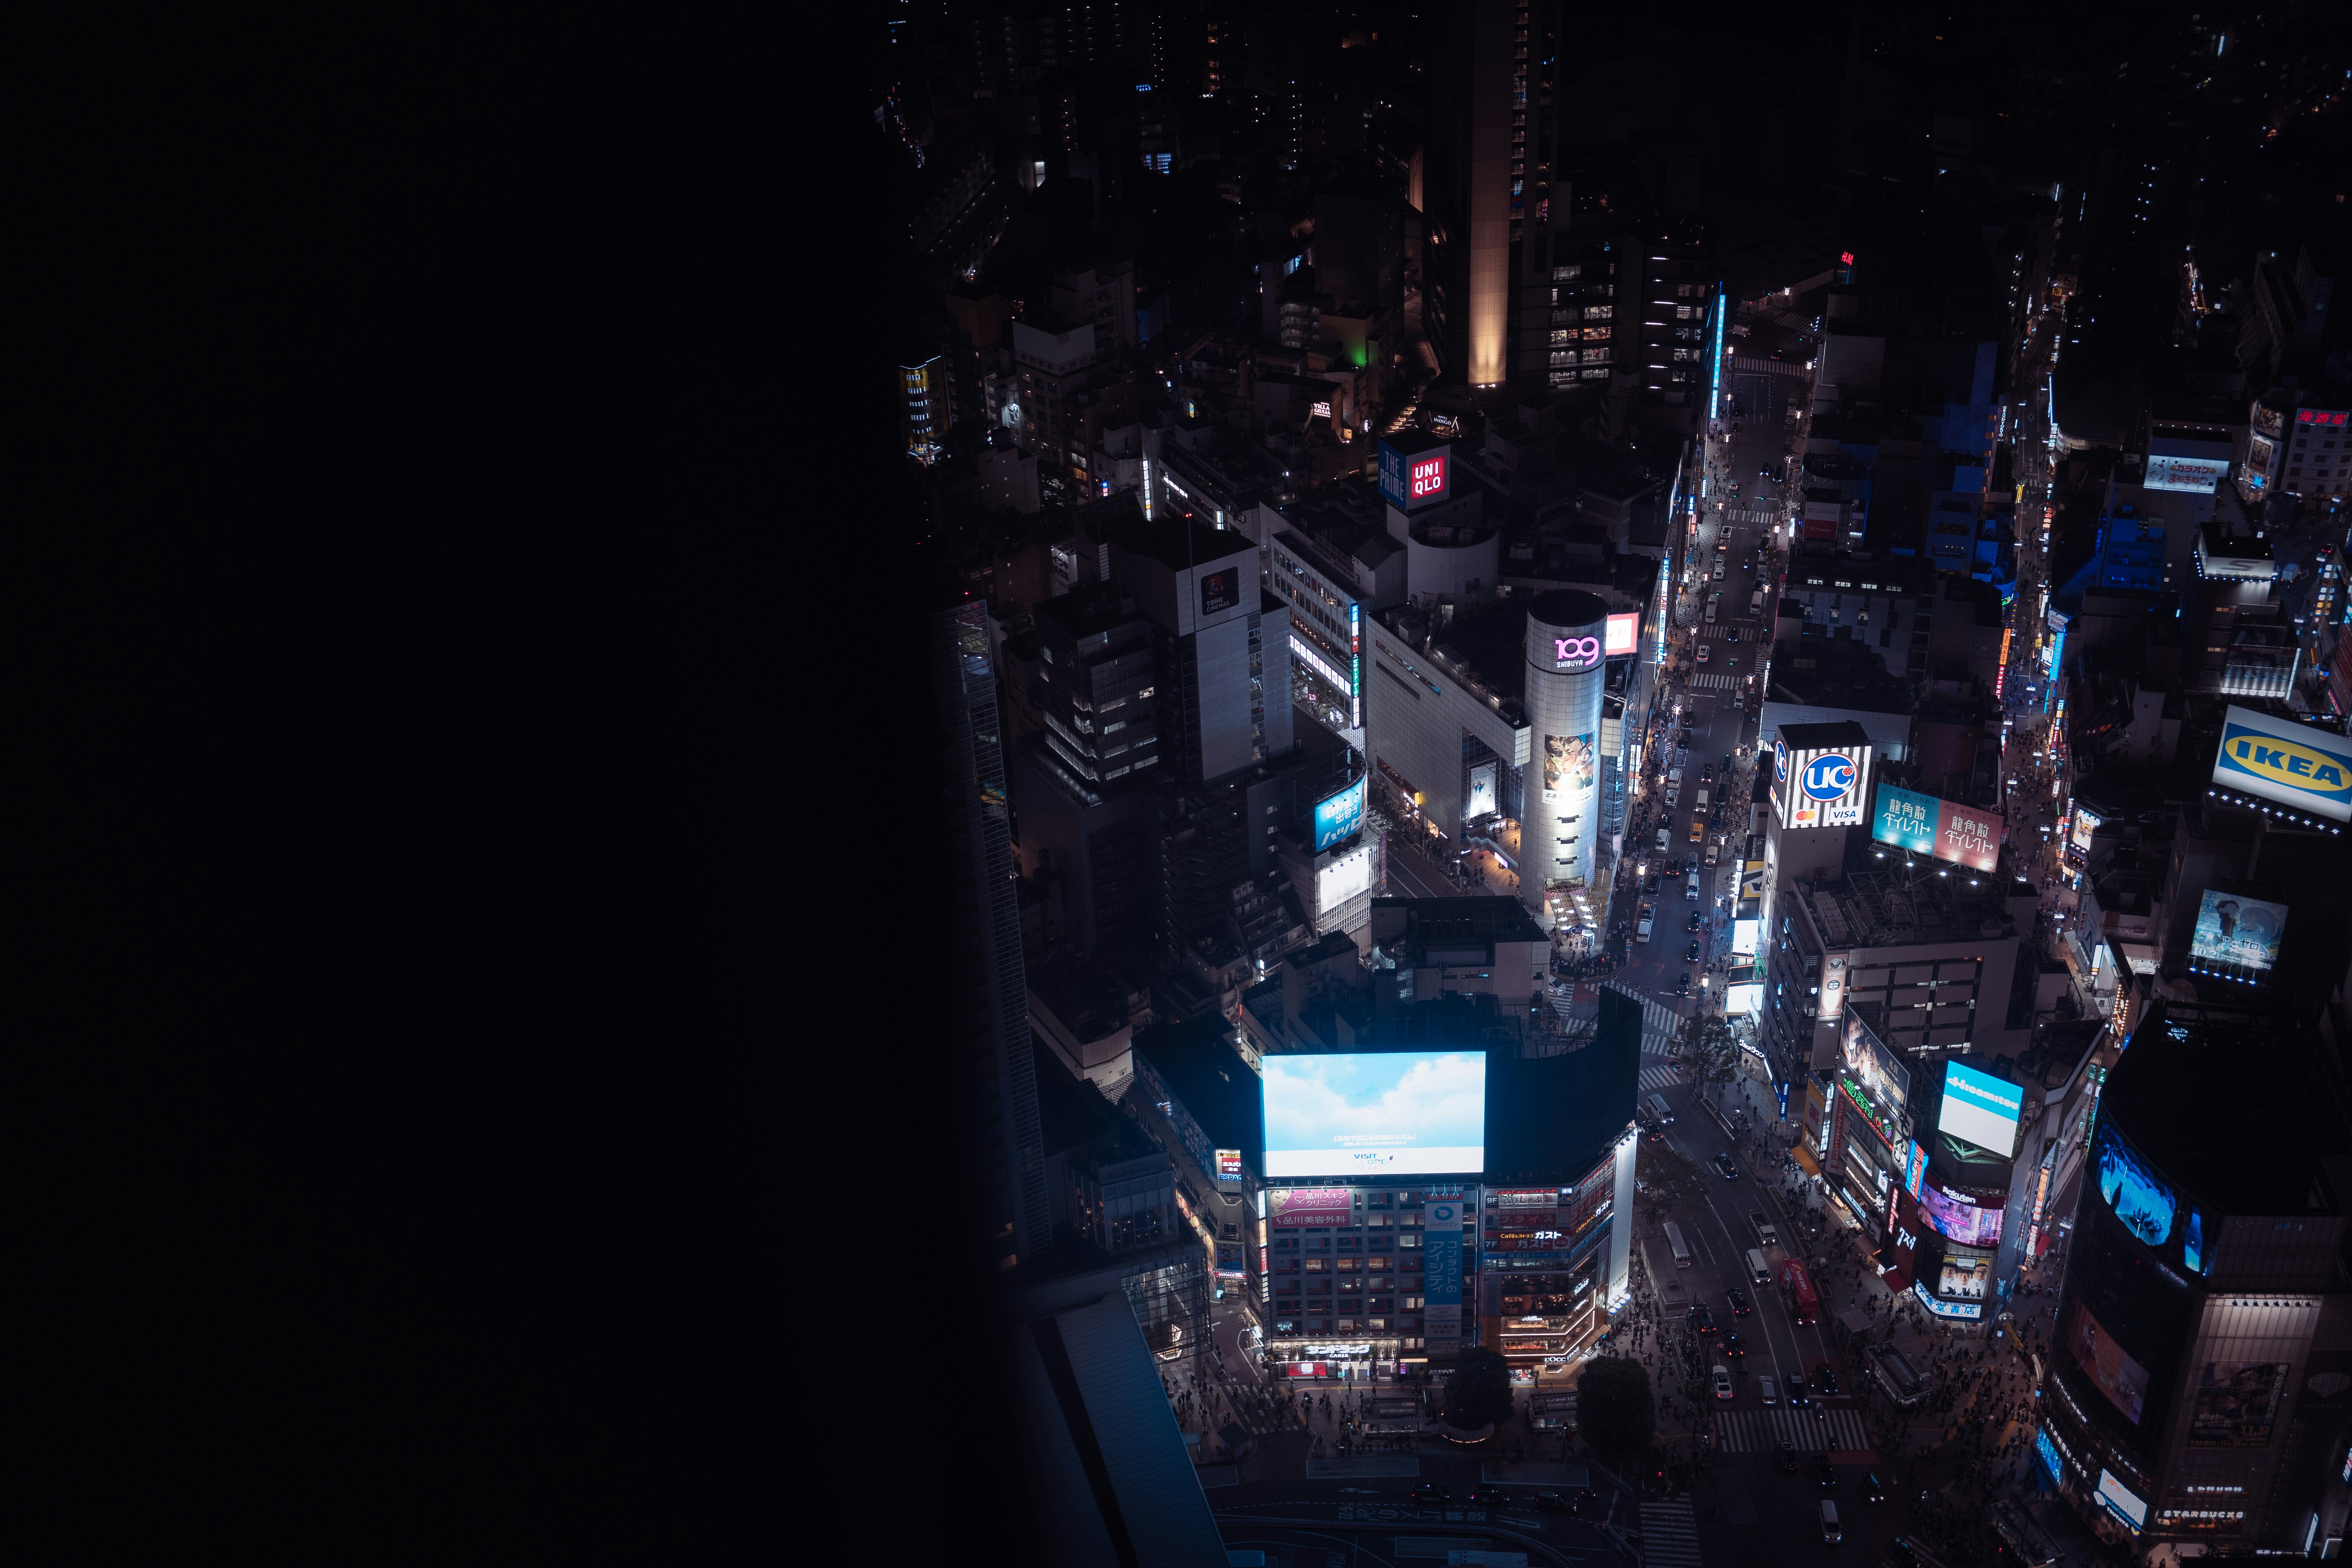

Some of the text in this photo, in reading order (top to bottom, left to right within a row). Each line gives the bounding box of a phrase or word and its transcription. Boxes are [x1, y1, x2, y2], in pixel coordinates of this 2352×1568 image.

[1841, 251, 1854, 266] H&M
[2297, 410, 2348, 425] 角海老
[1385, 451, 1399, 478] THE
[1415, 462, 1439, 480] UNI
[2176, 464, 2211, 474] カラオケ
[1380, 468, 1404, 502] PRIME
[1415, 476, 1441, 495] QLO
[2168, 473, 2209, 486] まねきねこ
[1207, 597, 1223, 607] TOHO
[1207, 600, 1230, 612] CINEMAS
[1555, 637, 1599, 666] 109
[2240, 646, 2284, 654] SKECHERS
[1557, 659, 1583, 668] SHIBUYA
[2236, 740, 2343, 788] IKEA
[1882, 787, 1936, 806] のど、直接、うるおう
[1833, 810, 1856, 819] VISA
[1889, 799, 1926, 821] 龍角散
[1944, 804, 2000, 823] のど、直接、うるおう
[1883, 812, 1931, 836] ダイレクト
[1887, 828, 1906, 837] スティック
[1951, 815, 1989, 839] 龍角散
[1945, 830, 1994, 854] ダイレクト
[1949, 845, 1967, 855] スティック
[1739, 1039, 1765, 1058] グルメタウン
[1878, 1067, 1893, 1093] GOLDEN
[1891, 1105, 1899, 1117] SAL
[1519, 1195, 1554, 1203] しゃぶ葉
[1943, 1185, 1976, 1204] Rakuten
[1595, 1200, 1611, 1217] ガスト
[1283, 1215, 1347, 1225] 品川美容外科
[1500, 1215, 1554, 1224] プライス
[1535, 1231, 1562, 1240] ガスト
[1897, 1226, 1916, 1250] クスリ
[1517, 1240, 1550, 1249] ガスト
[1429, 1241, 1444, 1293] アイシティ
[1445, 1240, 1458, 1293] コンタクトの
[1796, 1270, 1808, 1290] IBERIA
[1939, 1285, 1982, 1298] DMM
[1307, 1344, 1371, 1354] サンドラッグ
[2106, 1506, 2129, 1528] TSUTAYA
[2164, 1510, 2245, 1519] STARBUCKS
